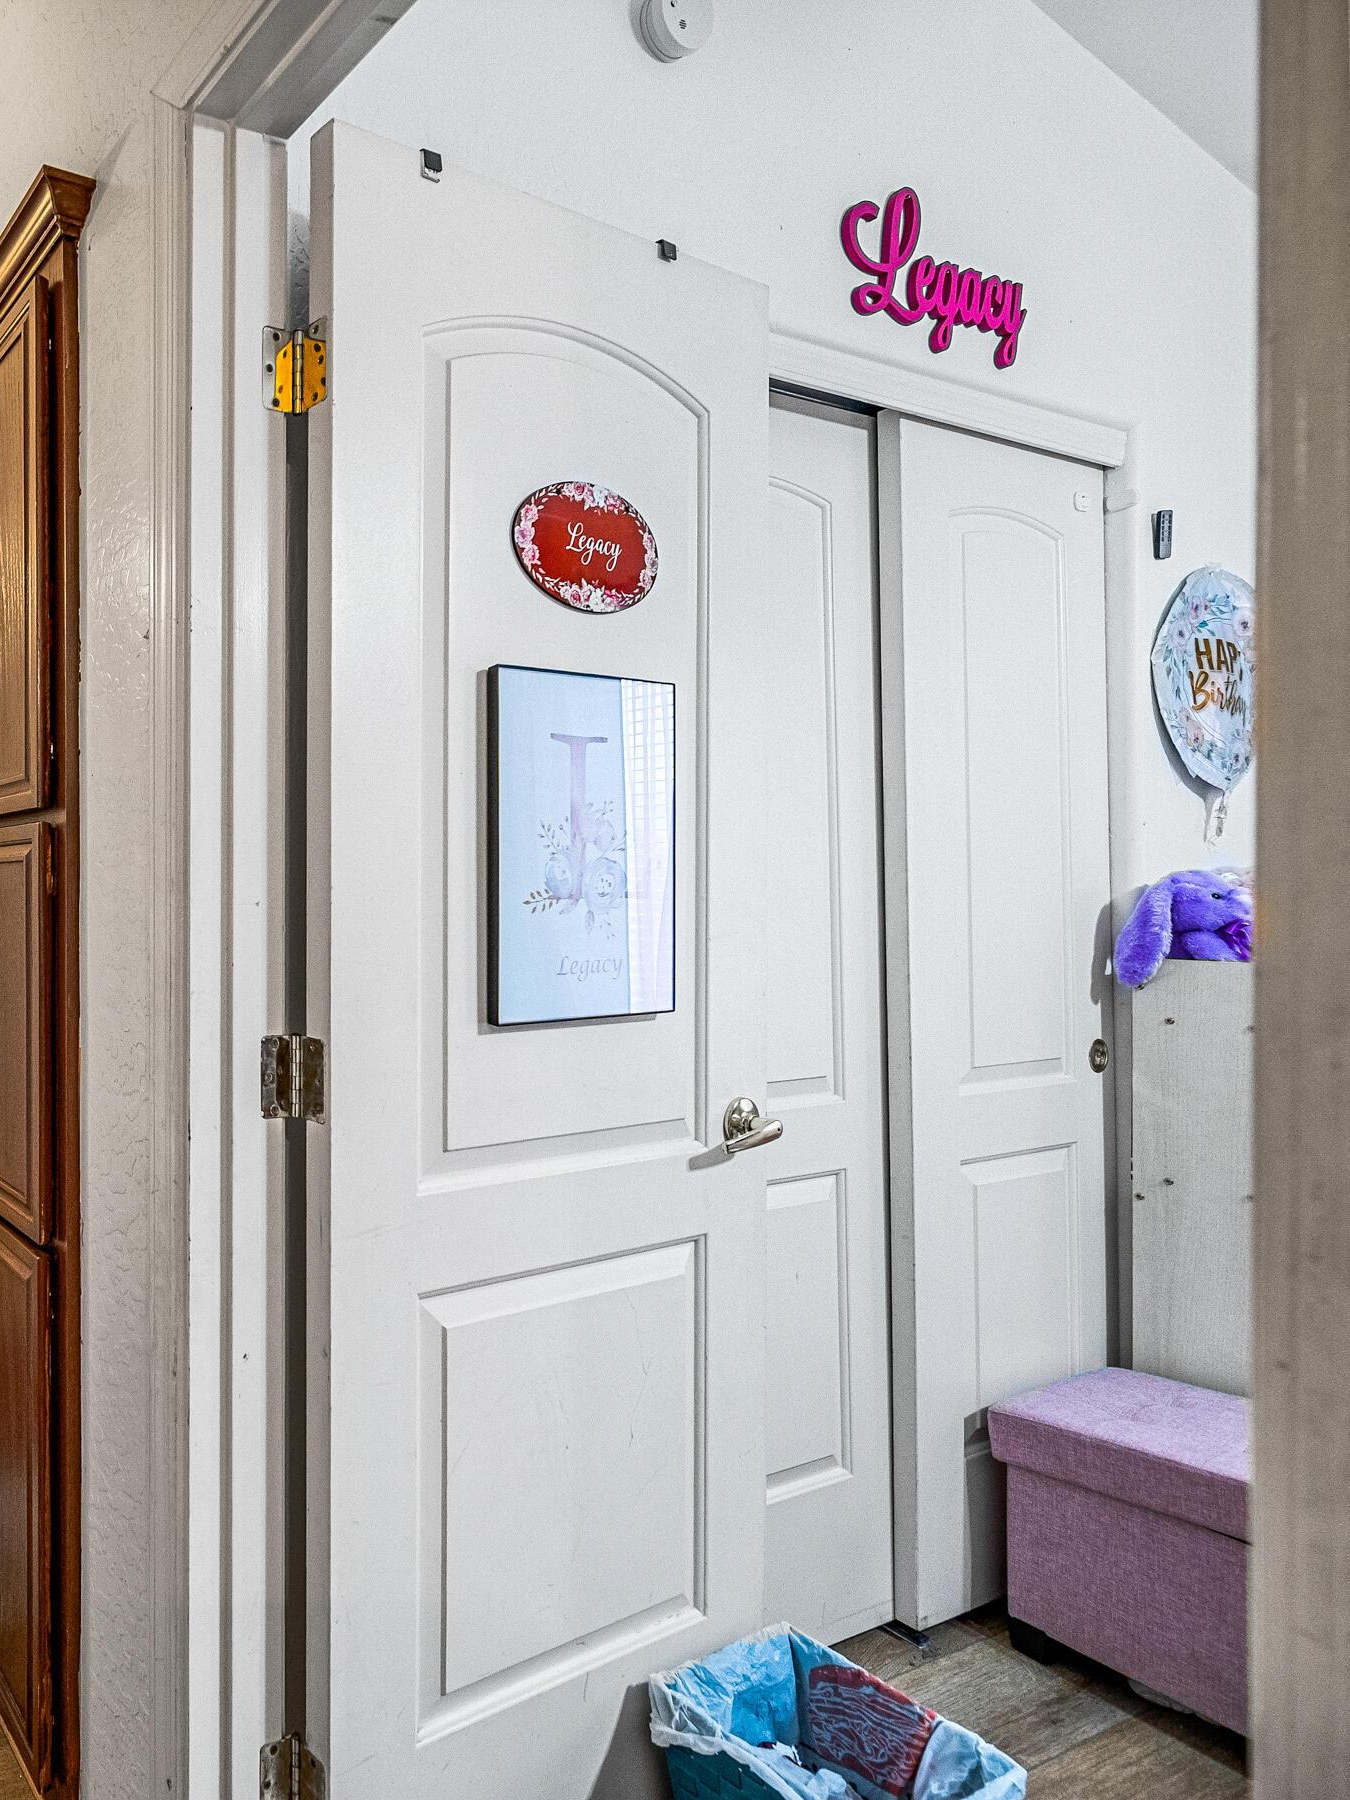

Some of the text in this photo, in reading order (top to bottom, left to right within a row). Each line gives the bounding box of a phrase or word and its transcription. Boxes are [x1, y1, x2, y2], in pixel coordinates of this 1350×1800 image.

[840, 187, 1027, 370] Legacy
[566, 522, 622, 572] Legacy
[557, 955, 623, 982] Legacy
